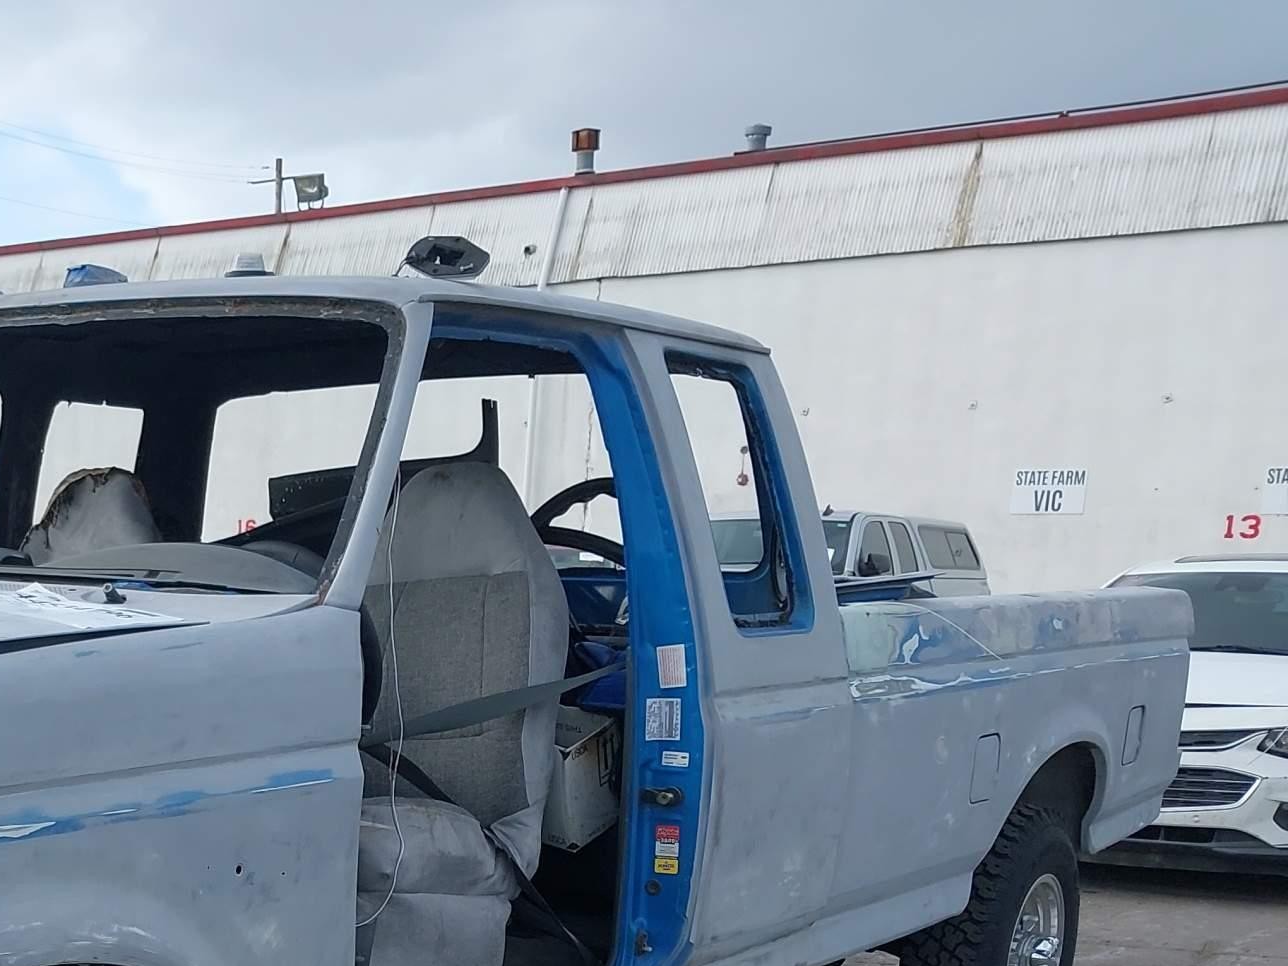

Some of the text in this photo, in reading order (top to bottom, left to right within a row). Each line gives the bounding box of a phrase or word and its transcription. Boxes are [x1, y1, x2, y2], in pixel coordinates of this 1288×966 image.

[1016, 470, 1086, 486] STATE FARM
[1034, 489, 1063, 512] VIC
[1223, 514, 1261, 539] 13
